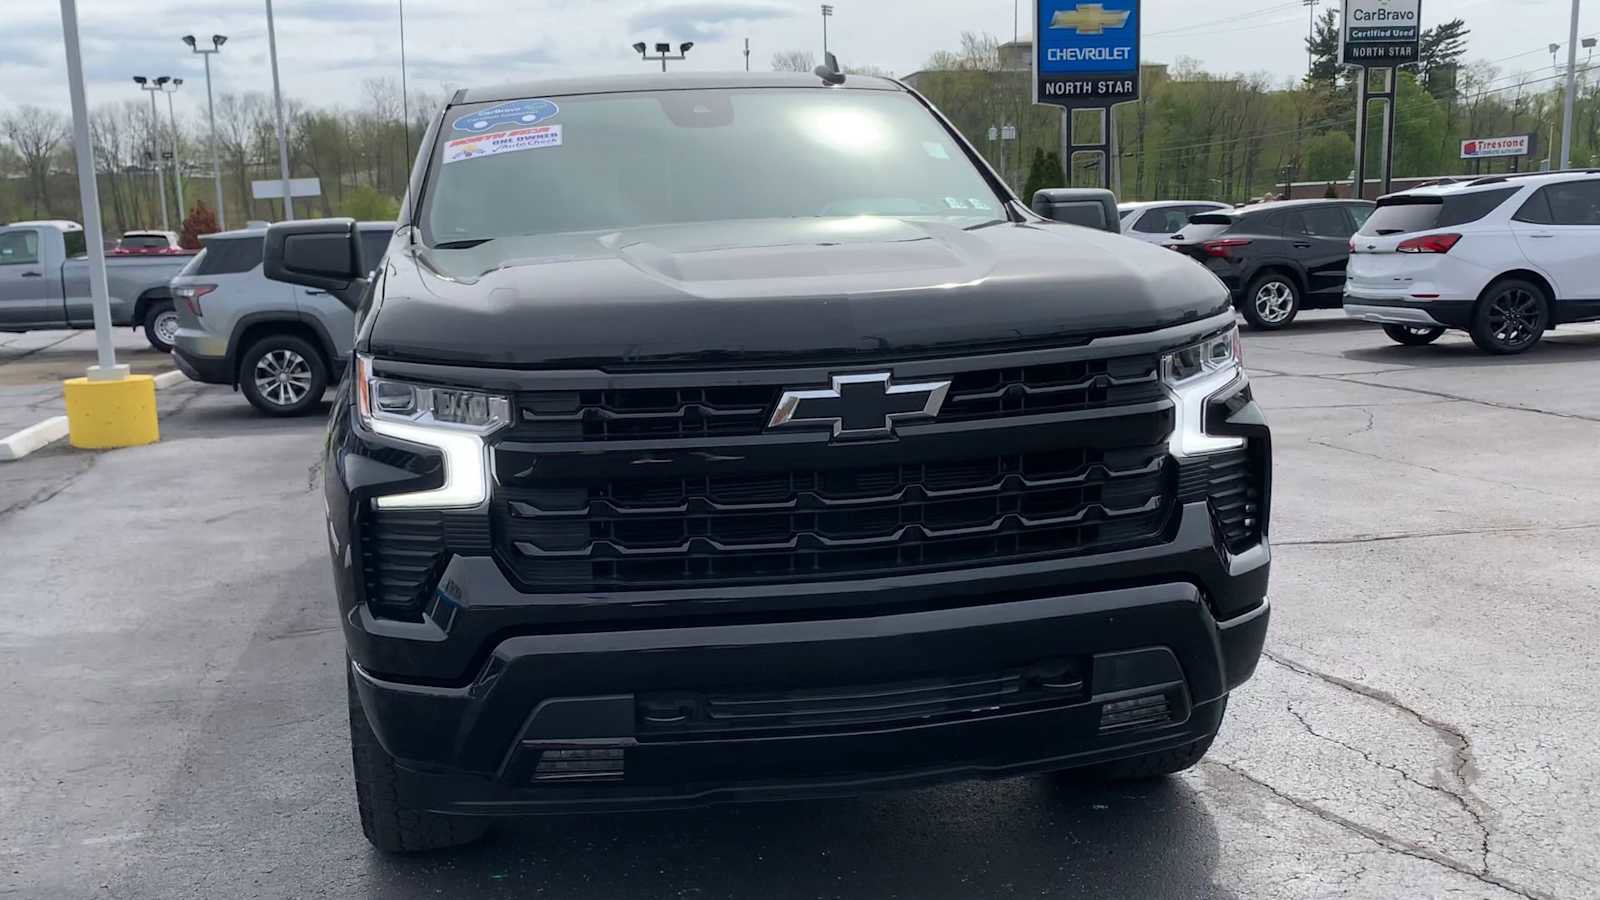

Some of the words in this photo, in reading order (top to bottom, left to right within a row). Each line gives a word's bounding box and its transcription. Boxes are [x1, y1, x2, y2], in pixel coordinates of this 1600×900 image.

[1353, 8, 1415, 21] CarBravo
[1352, 29, 1391, 38] Certified
[1393, 29, 1414, 37] Used
[1047, 46, 1131, 61] CHEVROLET
[1352, 47, 1385, 57] NORTH
[1388, 46, 1412, 57] STAR
[1045, 81, 1092, 95] NORTH
[1098, 80, 1133, 94] STAR
[1478, 139, 1525, 150] Firestone
